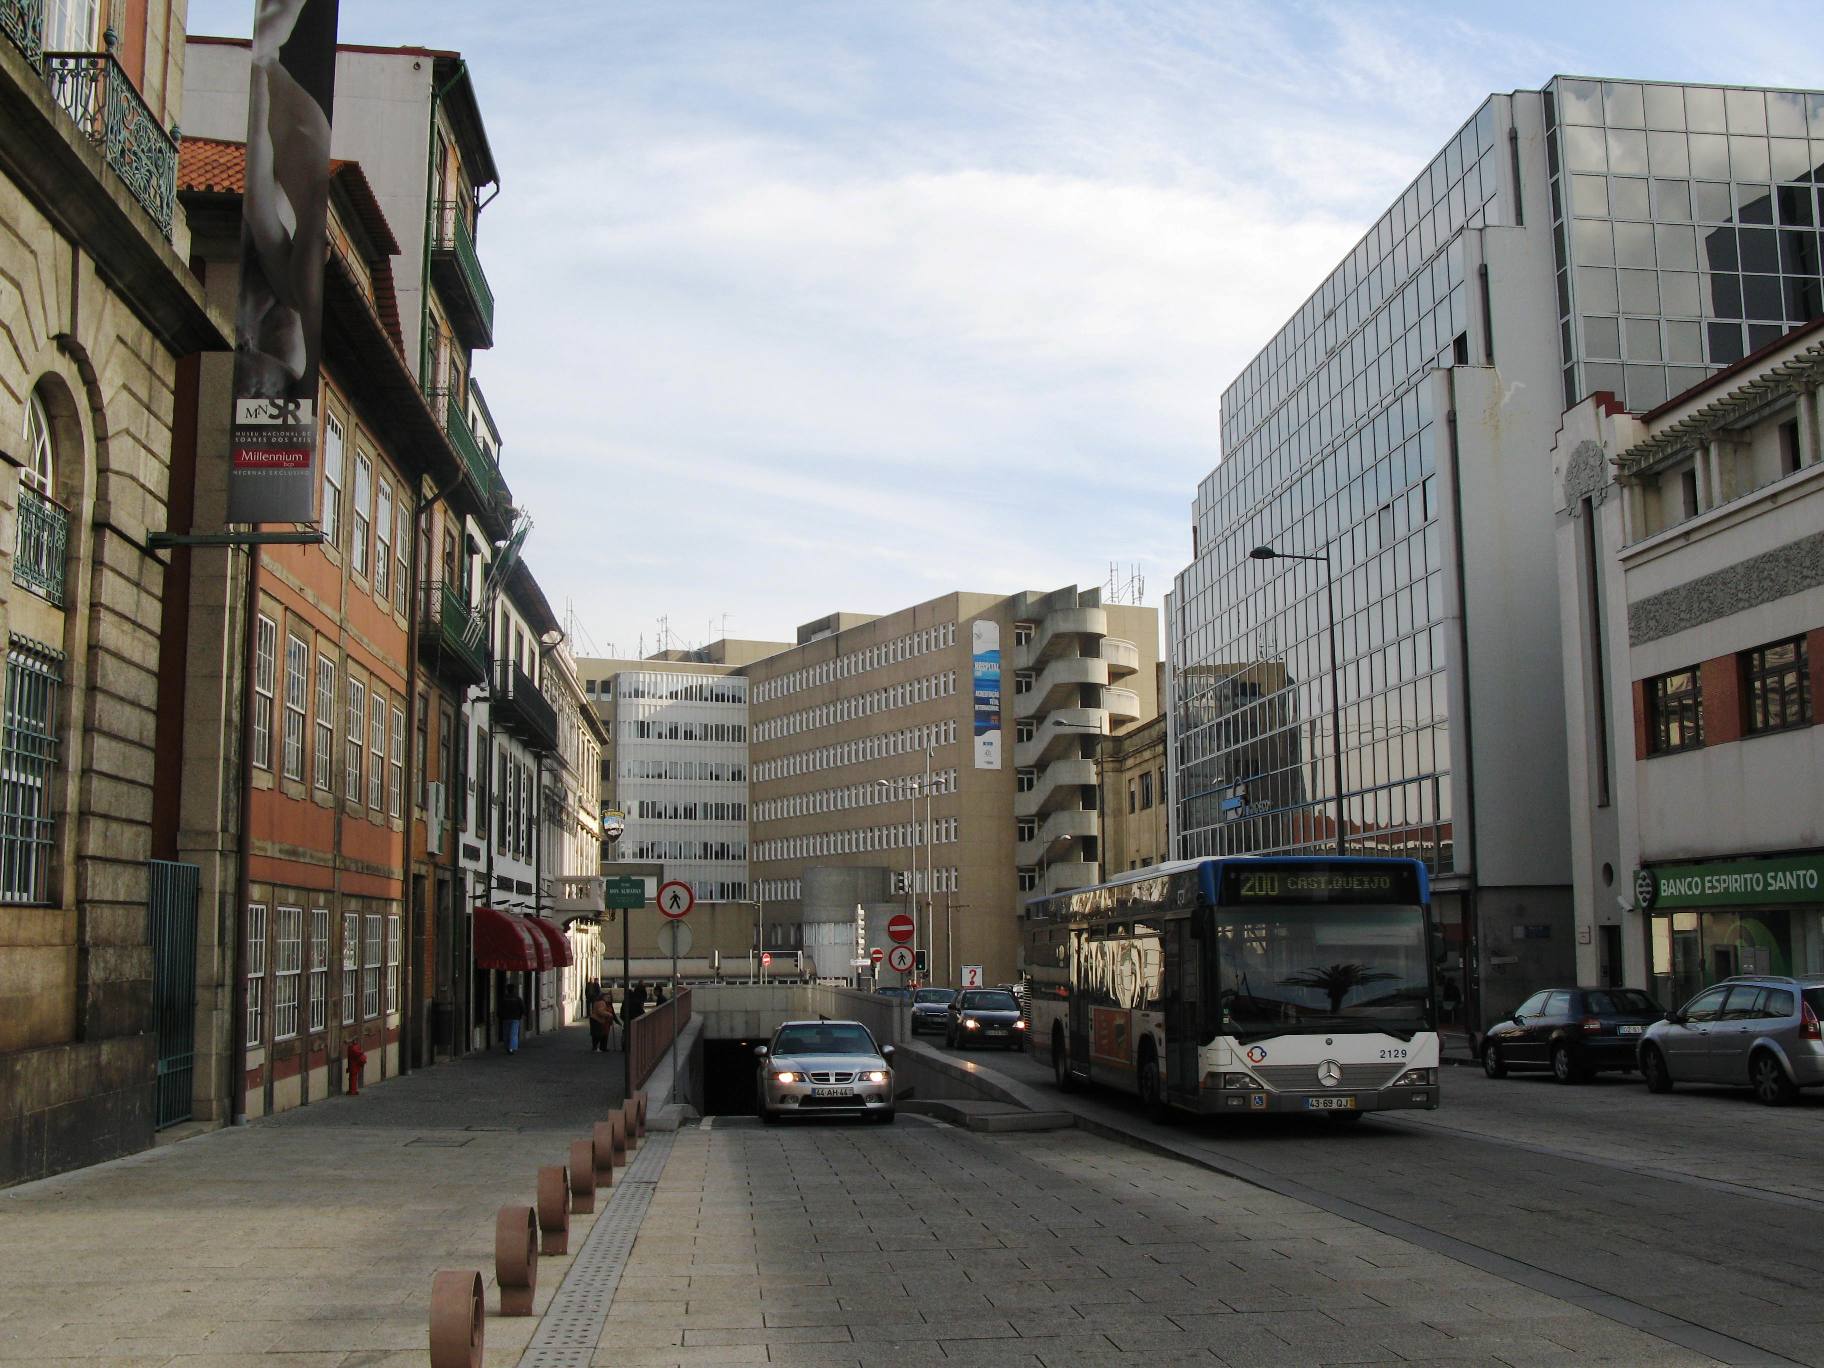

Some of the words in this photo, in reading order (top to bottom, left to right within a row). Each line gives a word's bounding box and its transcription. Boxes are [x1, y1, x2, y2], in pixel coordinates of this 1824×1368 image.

[241, 449, 303, 461] Millennium
[1240, 873, 1279, 896] 200
[1660, 876, 1702, 896] BANCO
[1704, 873, 1764, 894] ESPIRITO
[1767, 869, 1818, 891] SANTO
[1379, 1049, 1407, 1059] 2129
